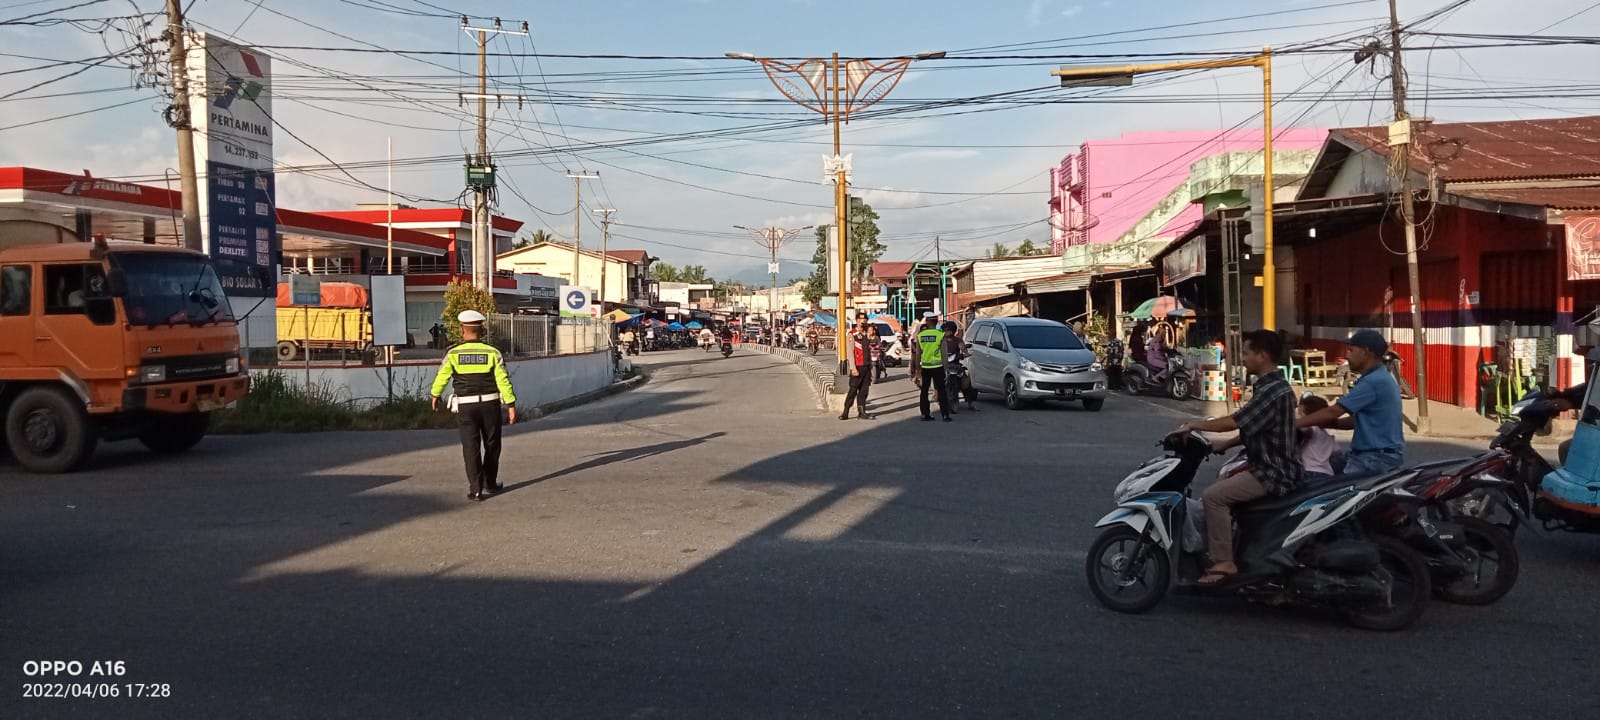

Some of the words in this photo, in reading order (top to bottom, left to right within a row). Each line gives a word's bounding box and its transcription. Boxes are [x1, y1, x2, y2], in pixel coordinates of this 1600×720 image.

[211, 113, 268, 136] PERTAMINA
[222, 275, 234, 288] BIO
[235, 277, 257, 289] SOLAR
[459, 355, 488, 364] POLISI
